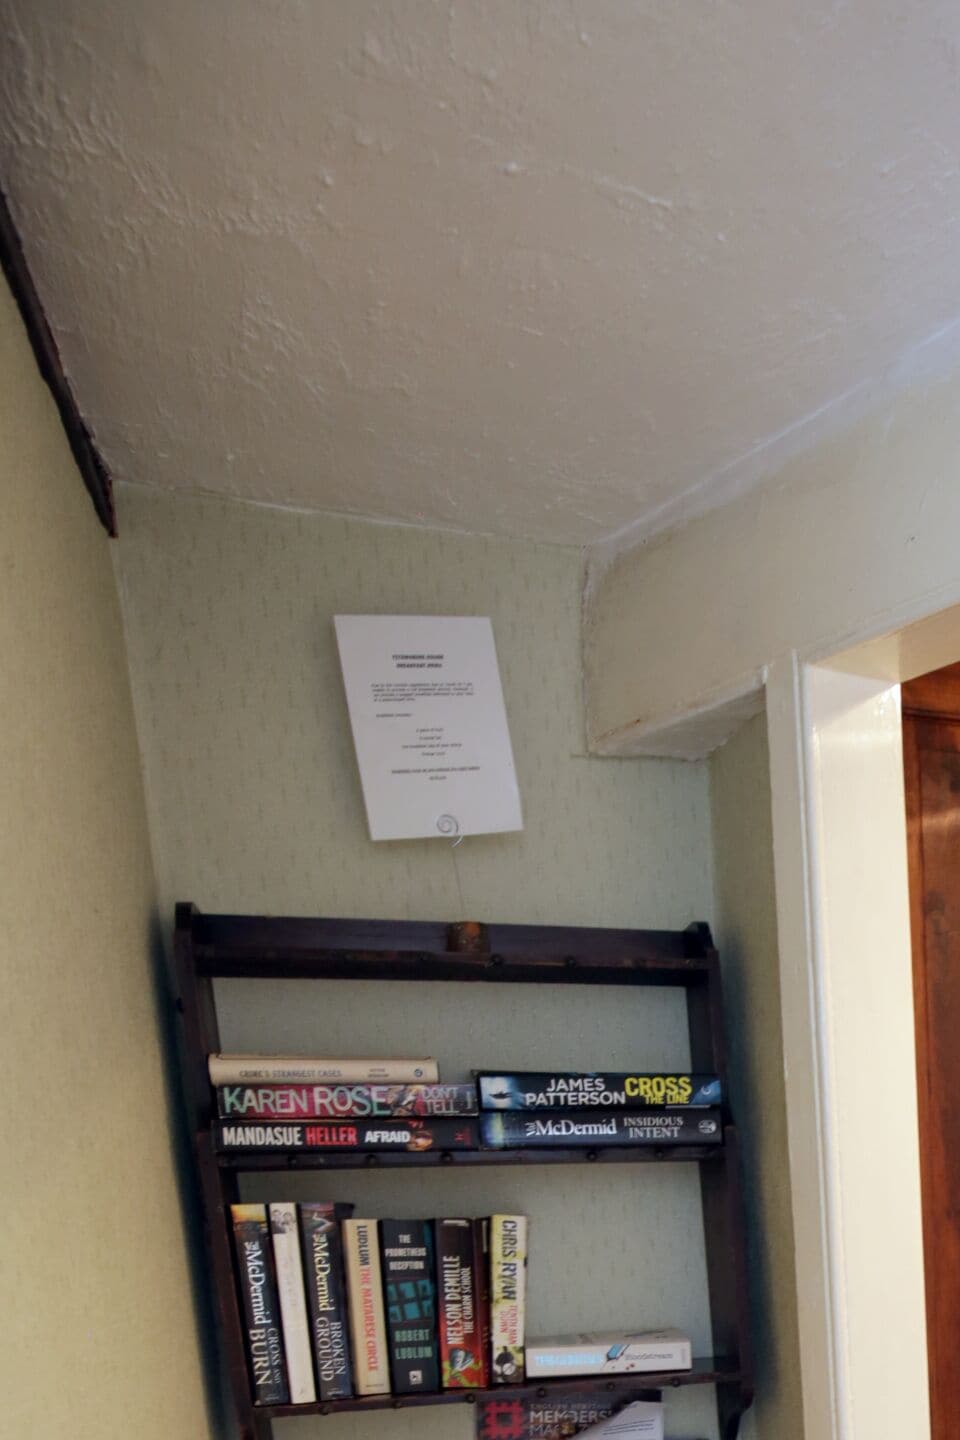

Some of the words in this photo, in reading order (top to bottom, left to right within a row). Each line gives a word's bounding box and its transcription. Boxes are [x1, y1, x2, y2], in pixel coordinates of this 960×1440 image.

[546, 1078, 606, 1092] JAMES
[624, 1076, 693, 1097] CROSS
[223, 1086, 309, 1114] KAREN
[309, 1085, 393, 1115] ROSE
[424, 1099, 460, 1114] TELL
[525, 1091, 626, 1107] PATTERSON
[644, 1095, 664, 1105] THE
[666, 1095, 690, 1105] LINE
[536, 1118, 618, 1137] McDermid
[623, 1116, 684, 1127] INSIDIOUS
[629, 1127, 681, 1139] INTENT
[223, 1126, 303, 1146] MANDASUE
[305, 1126, 358, 1146] HELLER
[364, 1130, 411, 1144] AFRAID
[502, 1219, 518, 1260] CHRIS
[246, 1249, 272, 1325] McDermid
[313, 1241, 335, 1312] McDermid
[502, 1261, 517, 1300] RYAN
[356, 1225, 371, 1266] LUDLUM
[366, 1338, 379, 1371] CIRCLE
[394, 1328, 430, 1342] ROBERT
[446, 1302, 465, 1345] NELSON
[249, 1328, 273, 1386] BURN
[315, 1316, 335, 1381] GROUND
[329, 1321, 346, 1375] BROKEN
